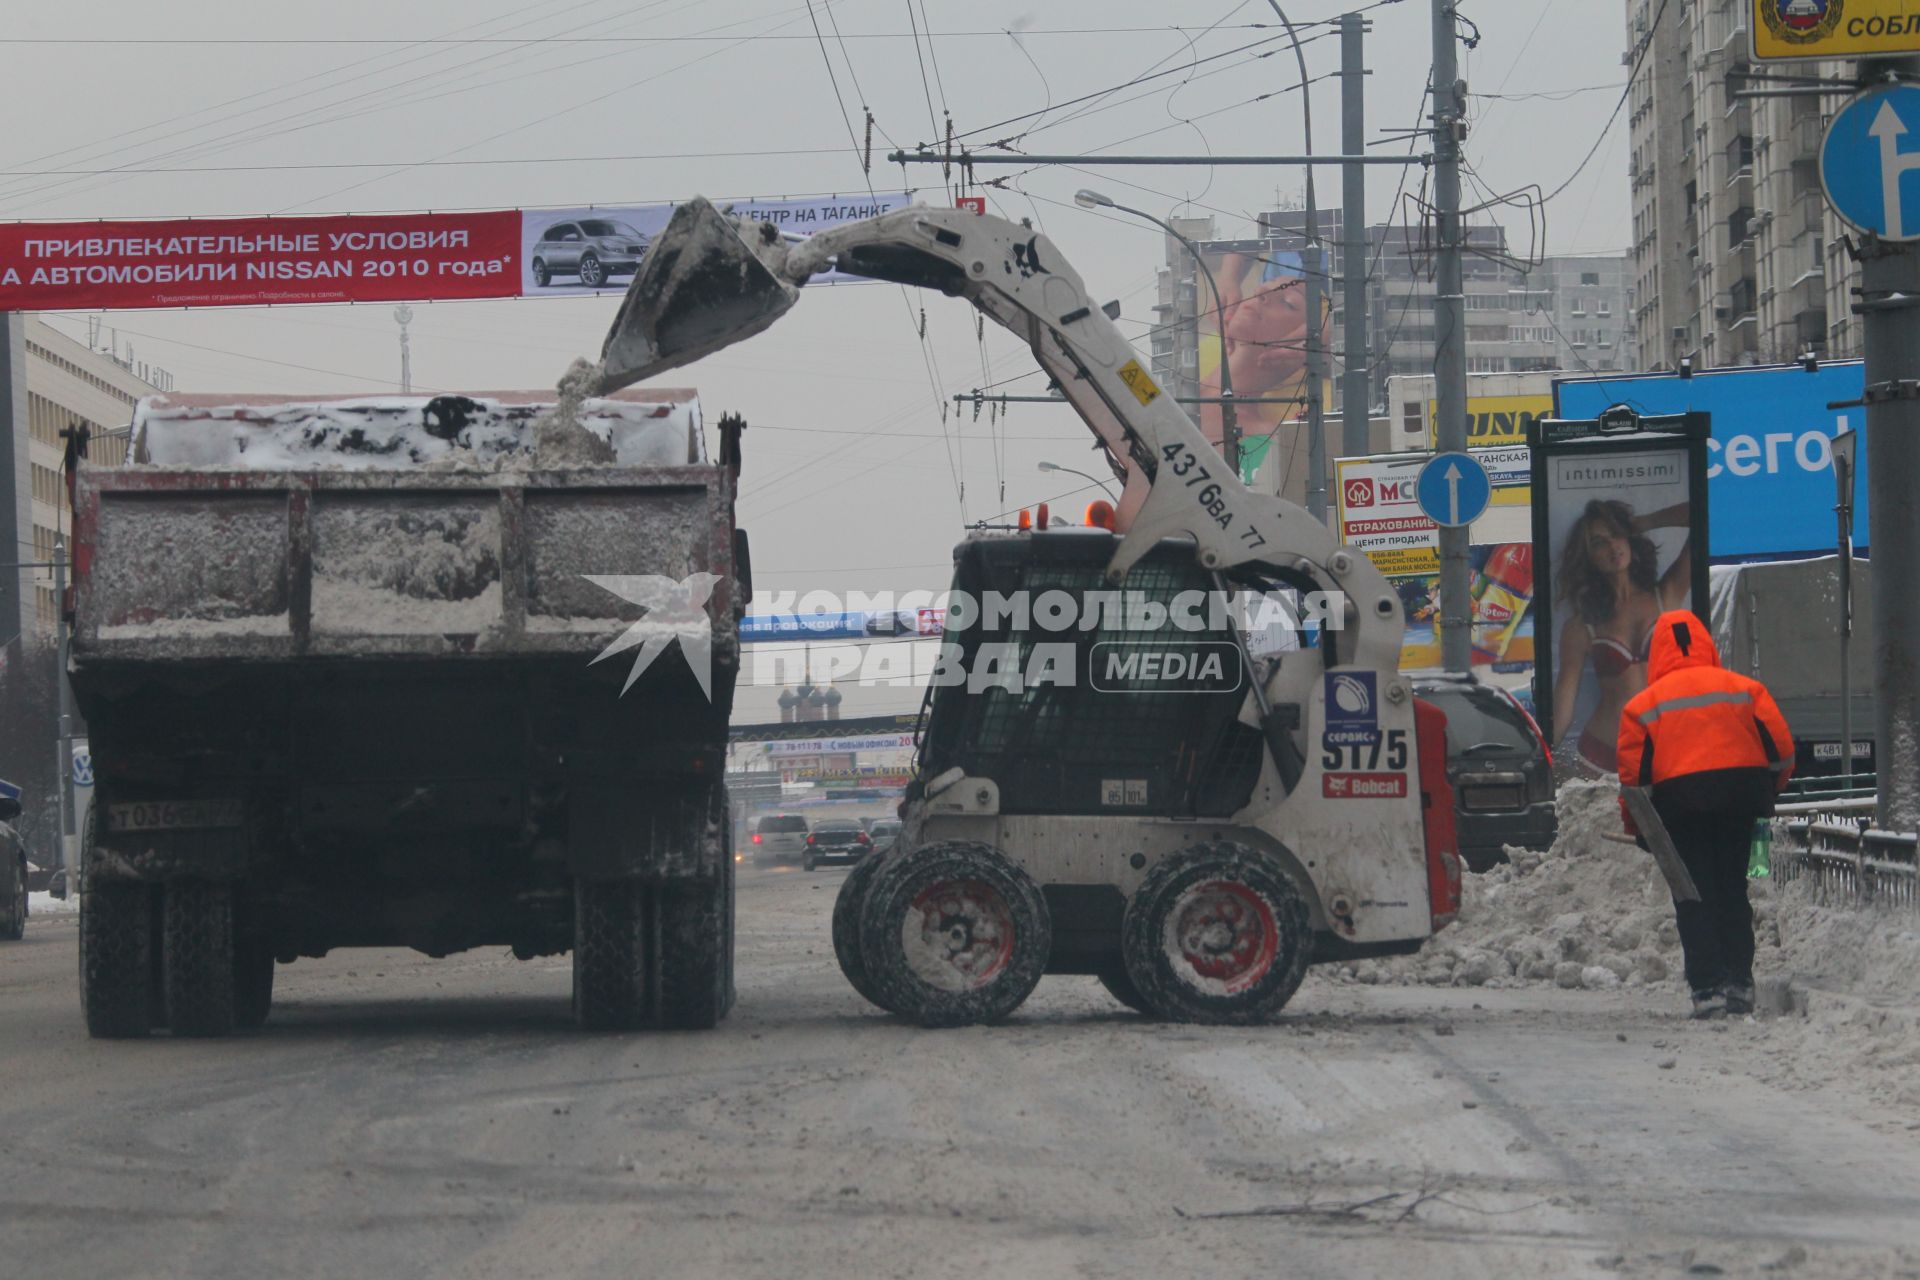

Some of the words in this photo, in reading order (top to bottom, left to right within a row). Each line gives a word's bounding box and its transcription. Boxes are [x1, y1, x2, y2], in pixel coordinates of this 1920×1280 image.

[795, 208, 816, 223] НА
[24, 234, 320, 258] ПРИВЛЕКАТЕЛЬНЫЕ
[328, 229, 469, 251] УСЛОВИЯ
[30, 263, 237, 286] АВТОМОБИЛИ
[246, 259, 353, 280] NISSAN
[362, 259, 430, 277] 2010
[1478, 452, 1528, 463] ГАНСКАЯ
[1489, 473, 1513, 481] SKAYA
[1566, 464, 1674, 481] intimissimi
[1379, 480, 1418, 501] МС
[1349, 518, 1435, 533] СТРАХОВАНИЕ
[1240, 525, 1266, 549] 77
[1355, 537, 1386, 548] ЦЕНТР
[1389, 534, 1430, 545] ПРОДАЖ
[1351, 779, 1400, 794] Bobcat
